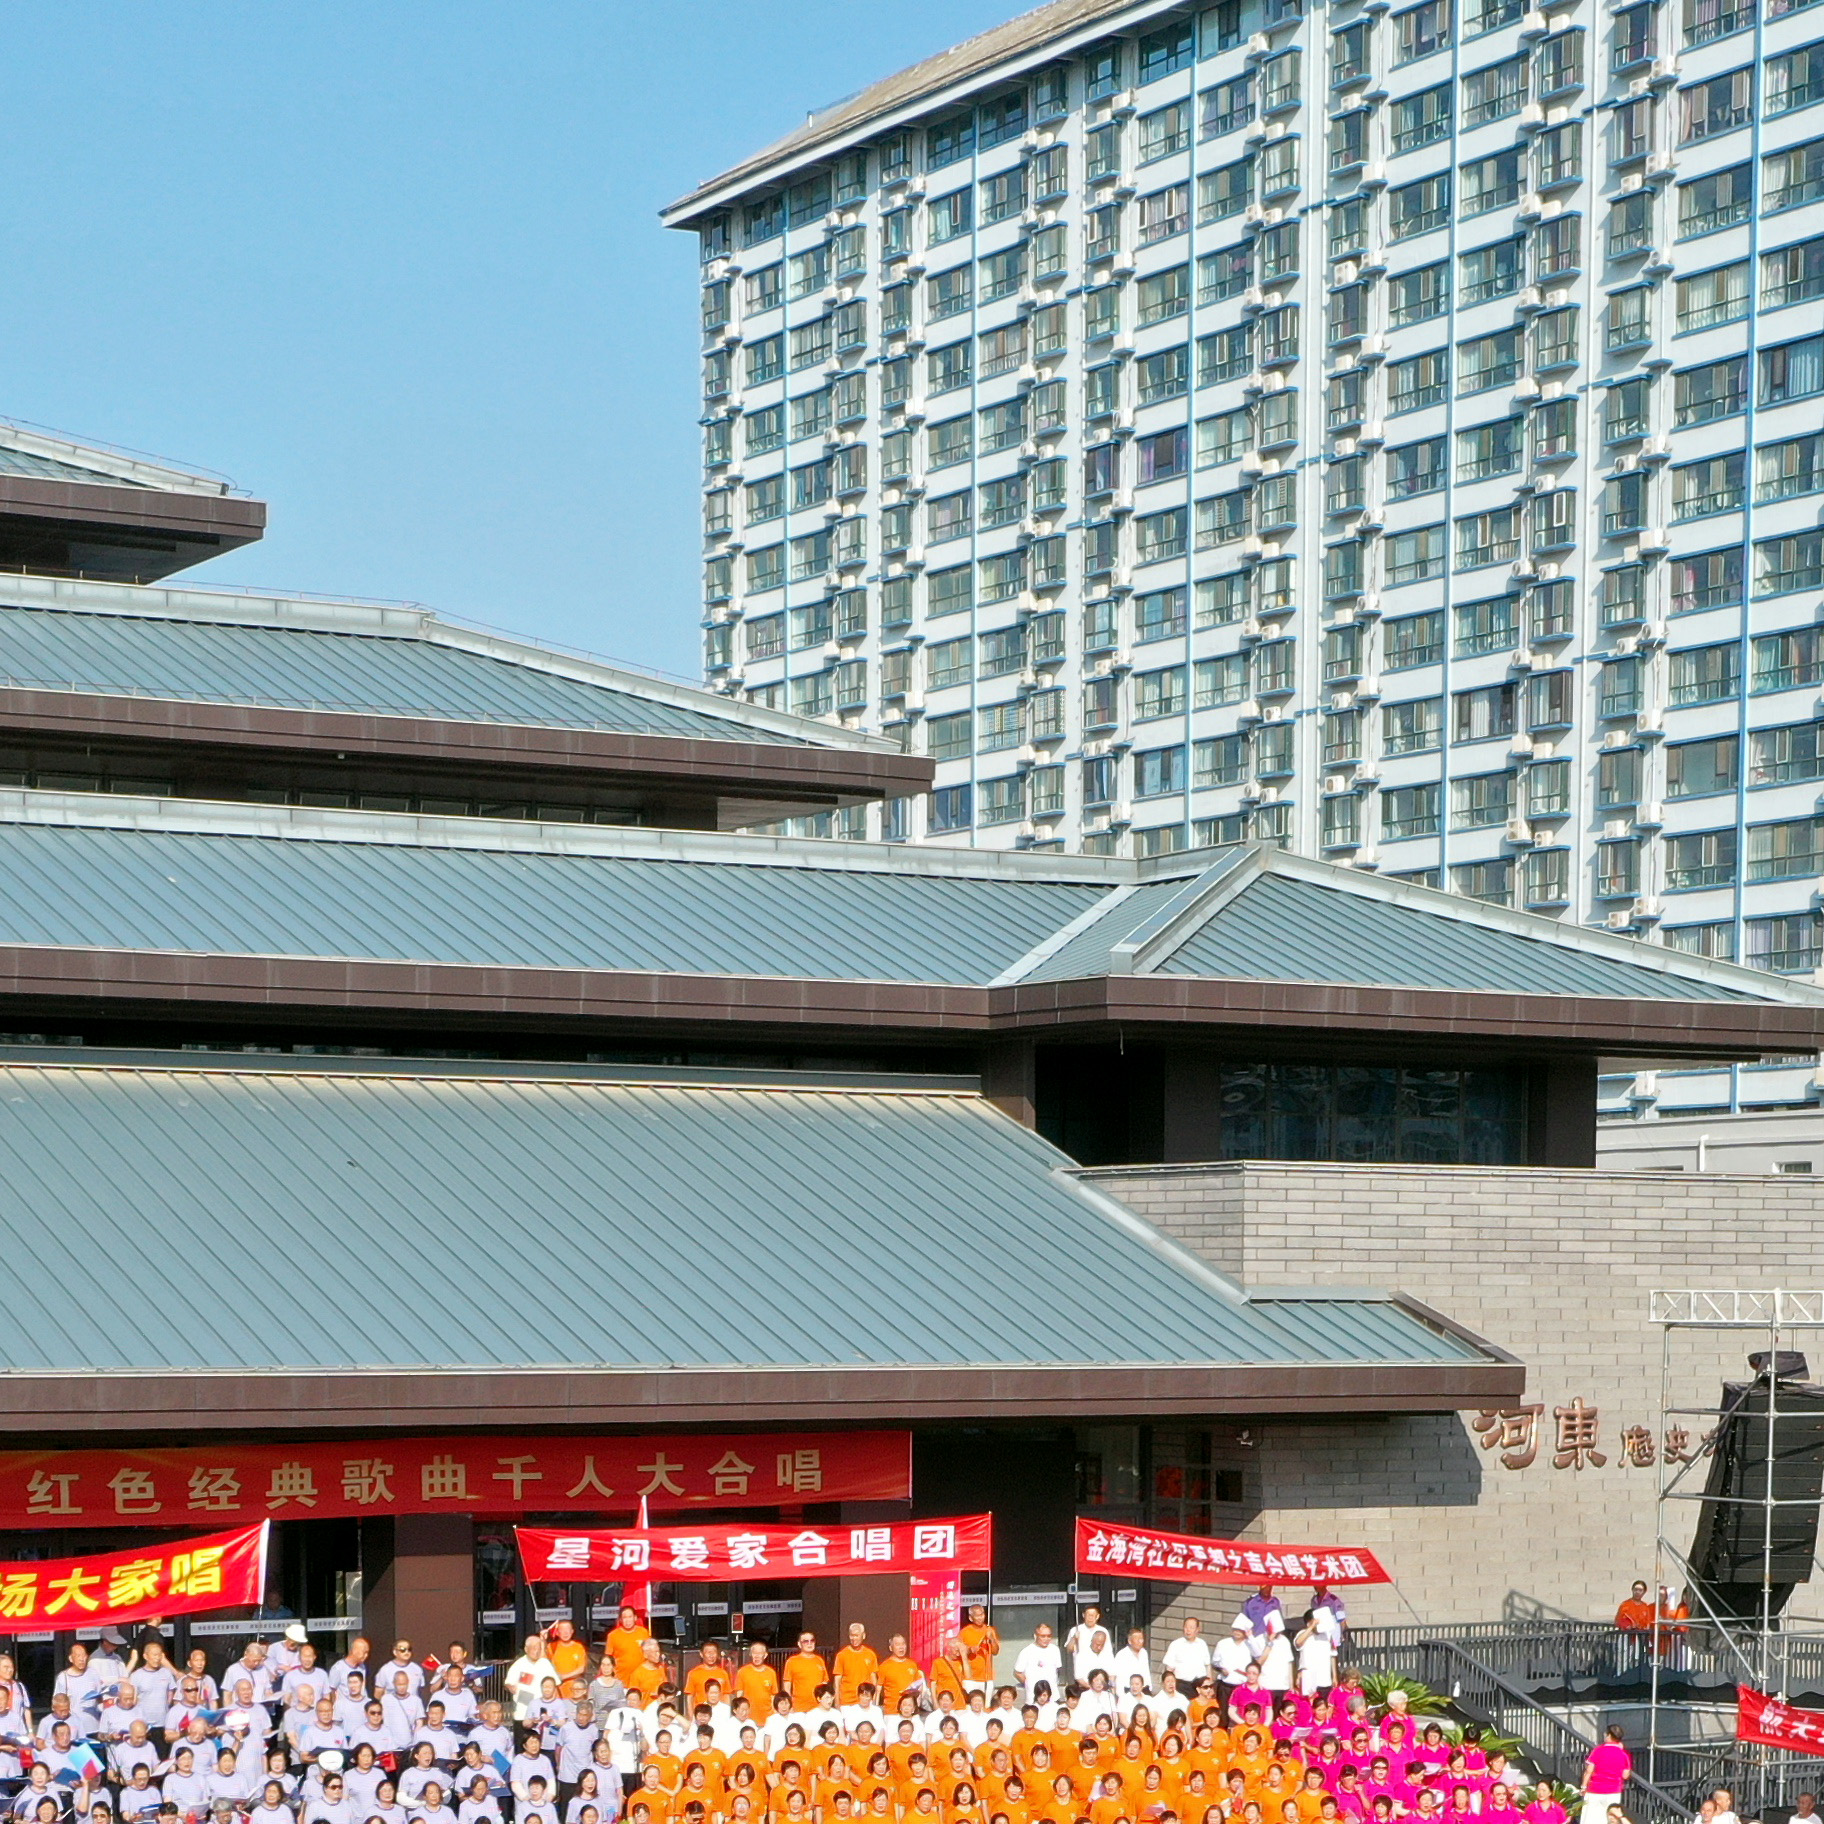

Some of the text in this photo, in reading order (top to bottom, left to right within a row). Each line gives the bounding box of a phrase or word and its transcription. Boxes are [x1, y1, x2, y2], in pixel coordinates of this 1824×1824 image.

[546, 1523, 956, 1572] 星河爱家合唱团
